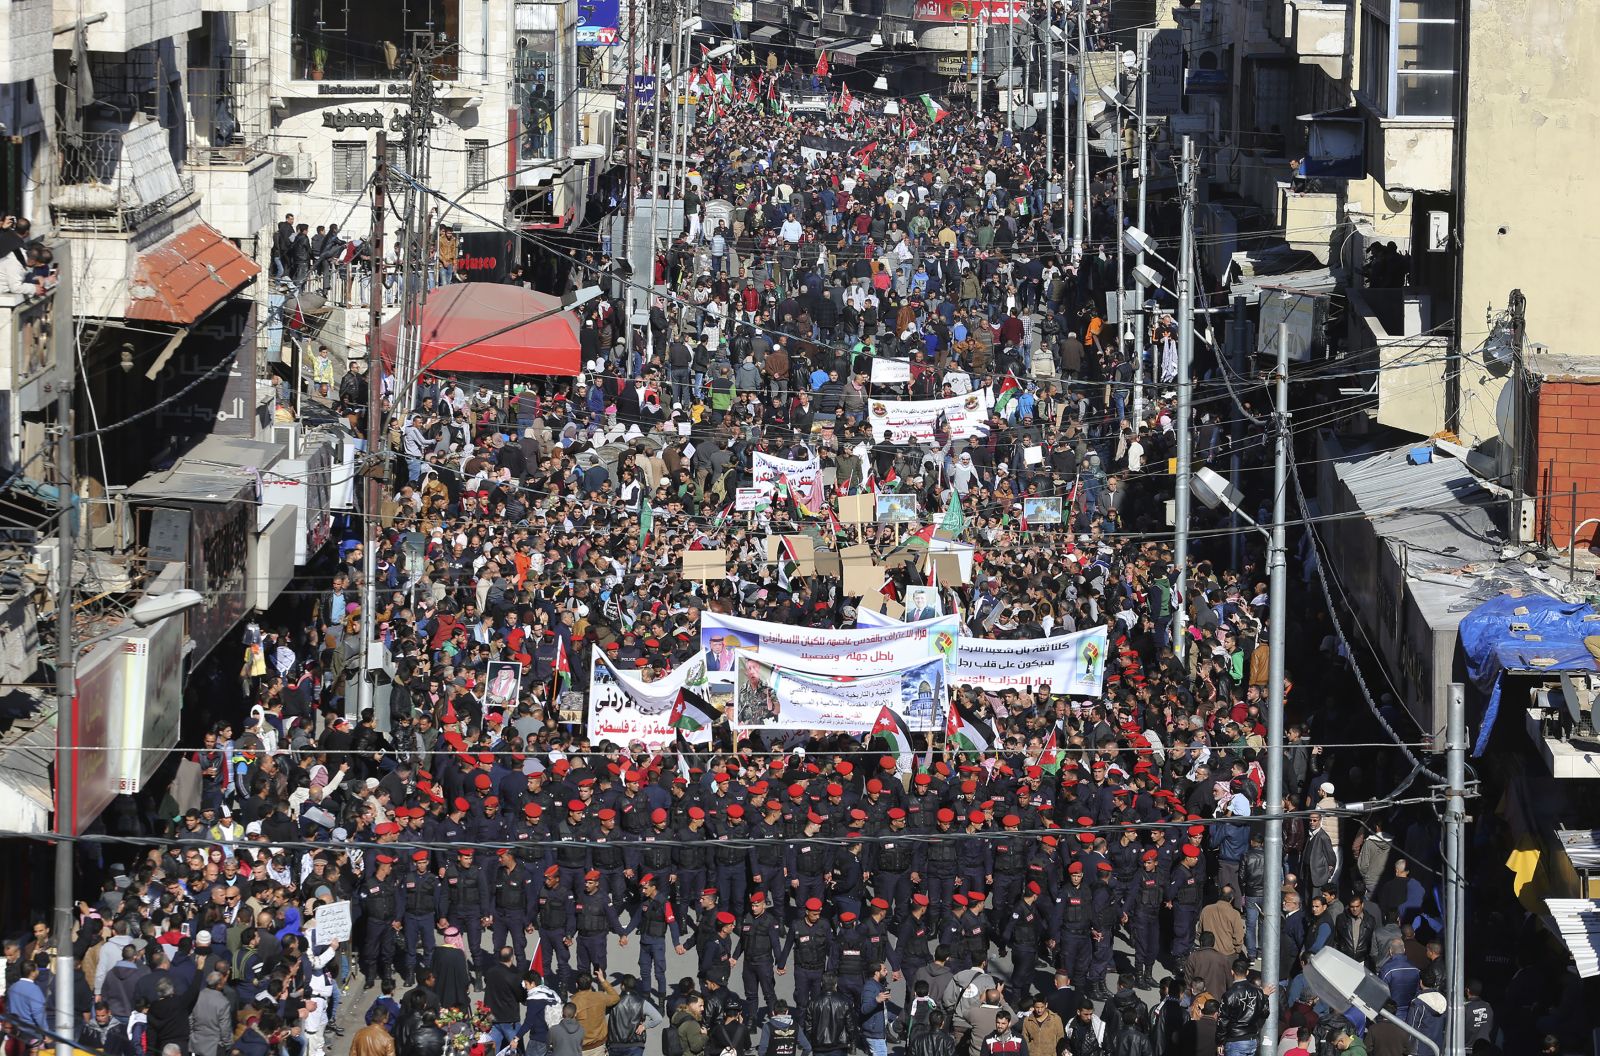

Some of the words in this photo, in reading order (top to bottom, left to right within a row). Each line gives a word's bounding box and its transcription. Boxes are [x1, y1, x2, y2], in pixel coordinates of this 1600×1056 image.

[600, 33, 616, 43] TV
[317, 84, 380, 95] Mahmoud
[853, 633, 882, 646] بالقدس
[1051, 641, 1070, 651] كلنا
[870, 651, 894, 662] باطل
[975, 658, 996, 668] قلب
[999, 659, 1015, 669] على
[595, 719, 630, 736] فلسطين
